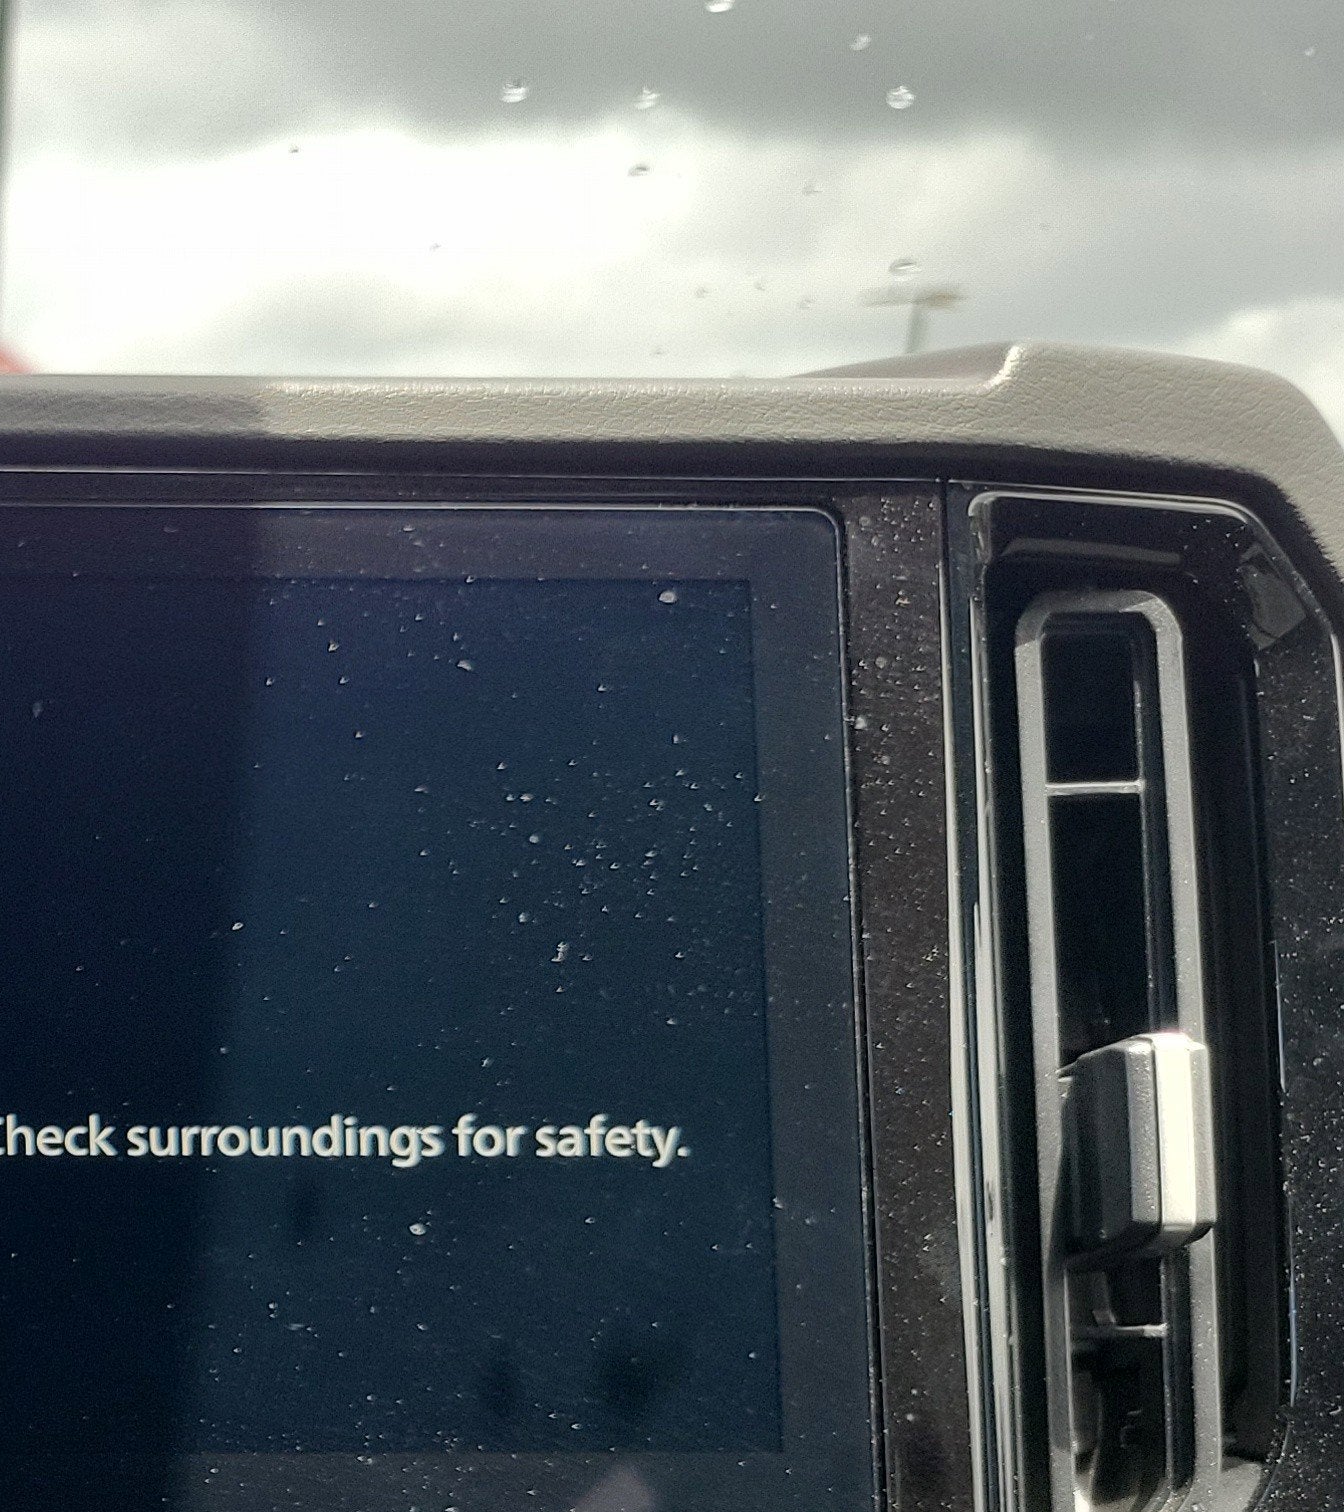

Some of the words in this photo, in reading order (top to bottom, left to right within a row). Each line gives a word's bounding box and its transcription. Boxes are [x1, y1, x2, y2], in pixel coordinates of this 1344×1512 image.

[126, 1113, 444, 1167] surroundings
[453, 1113, 526, 1158] for
[535, 1113, 691, 1168] safety.
